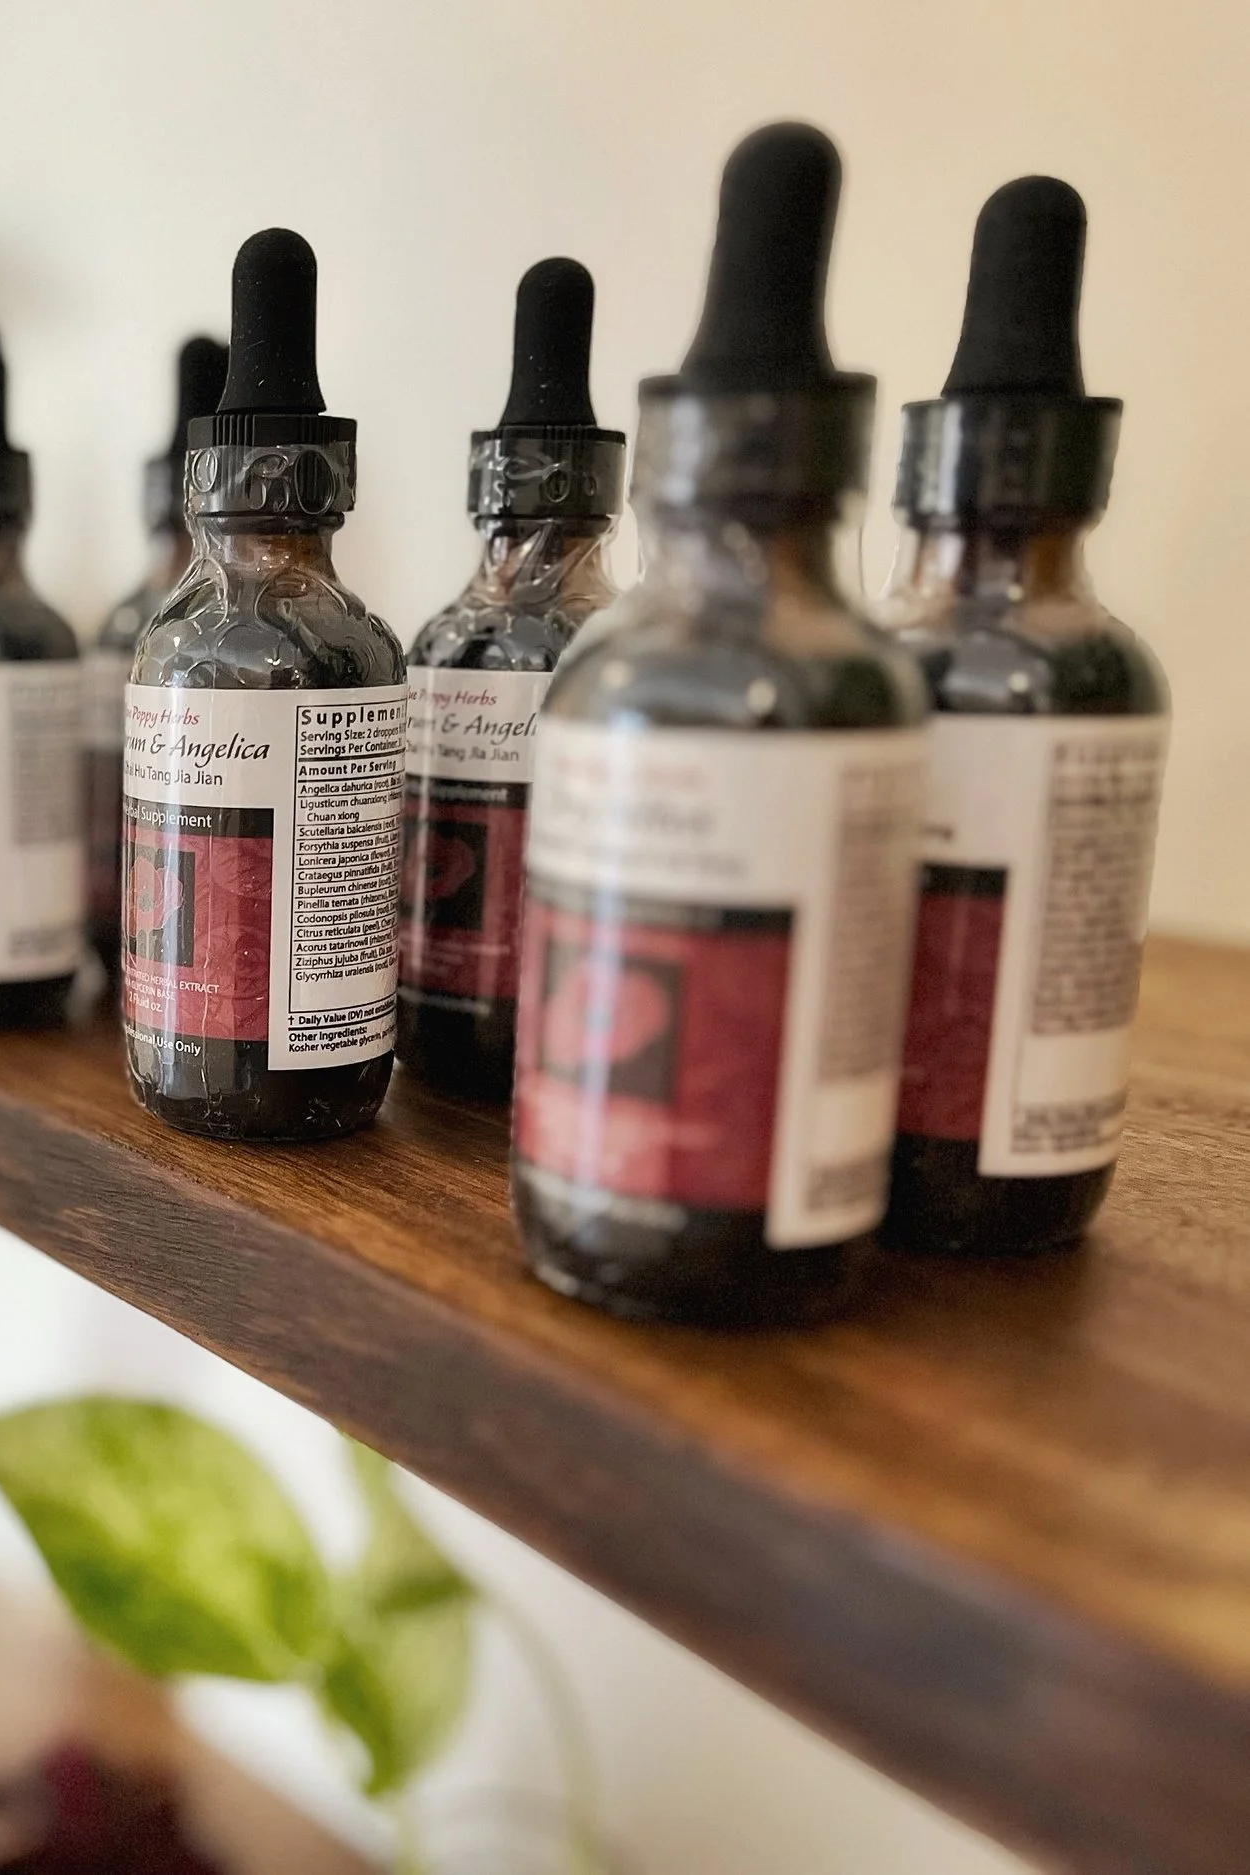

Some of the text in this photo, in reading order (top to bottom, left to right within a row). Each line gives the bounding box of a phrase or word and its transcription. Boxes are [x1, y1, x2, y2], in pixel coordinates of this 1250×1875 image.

[441, 713, 460, 734] &
[301, 730, 342, 744] Serving
[367, 728, 372, 739] 2
[150, 733, 166, 755] &
[170, 732, 271, 768] Angelica
[300, 744, 346, 757] Servings
[348, 742, 364, 754] Per
[147, 766, 171, 786] Tang
[174, 769, 192, 784] Jia
[194, 771, 223, 786] Jian
[298, 764, 348, 777] Amount
[350, 763, 367, 774] Per
[300, 784, 340, 797] Angelica
[341, 781, 373, 793] dahurica
[300, 798, 349, 811] Ligusticum
[141, 806, 212, 828] Supplement
[306, 811, 336, 822] Chuan
[299, 826, 345, 837] Scutellaria
[299, 840, 340, 853] Forsythia
[341, 837, 374, 851] suspensa
[299, 856, 337, 867] Lonicera
[338, 852, 370, 867] japonica
[298, 870, 343, 883] Crataegus
[297, 885, 347, 897] Bupleurum
[297, 900, 330, 910] Pinellia
[297, 913, 348, 926] Codonopsis
[296, 928, 323, 939] Citrus
[324, 924, 361, 937] reticulata
[296, 942, 327, 953] Acorus
[295, 956, 334, 968] Ziziphus
[335, 953, 359, 967] jujuba
[295, 969, 344, 982] Glycyrrhiza
[179, 980, 220, 995] EXTRACT
[298, 1014, 322, 1027] Daily
[323, 1011, 347, 1024] Value
[347, 1008, 364, 1022] (DV)
[288, 1031, 318, 1043] Other
[319, 1026, 369, 1042] Ingredients:
[156, 1036, 175, 1050] Use
[175, 1040, 202, 1057] Only
[289, 1042, 320, 1053] Kosher
[320, 1038, 359, 1052] vegetable
